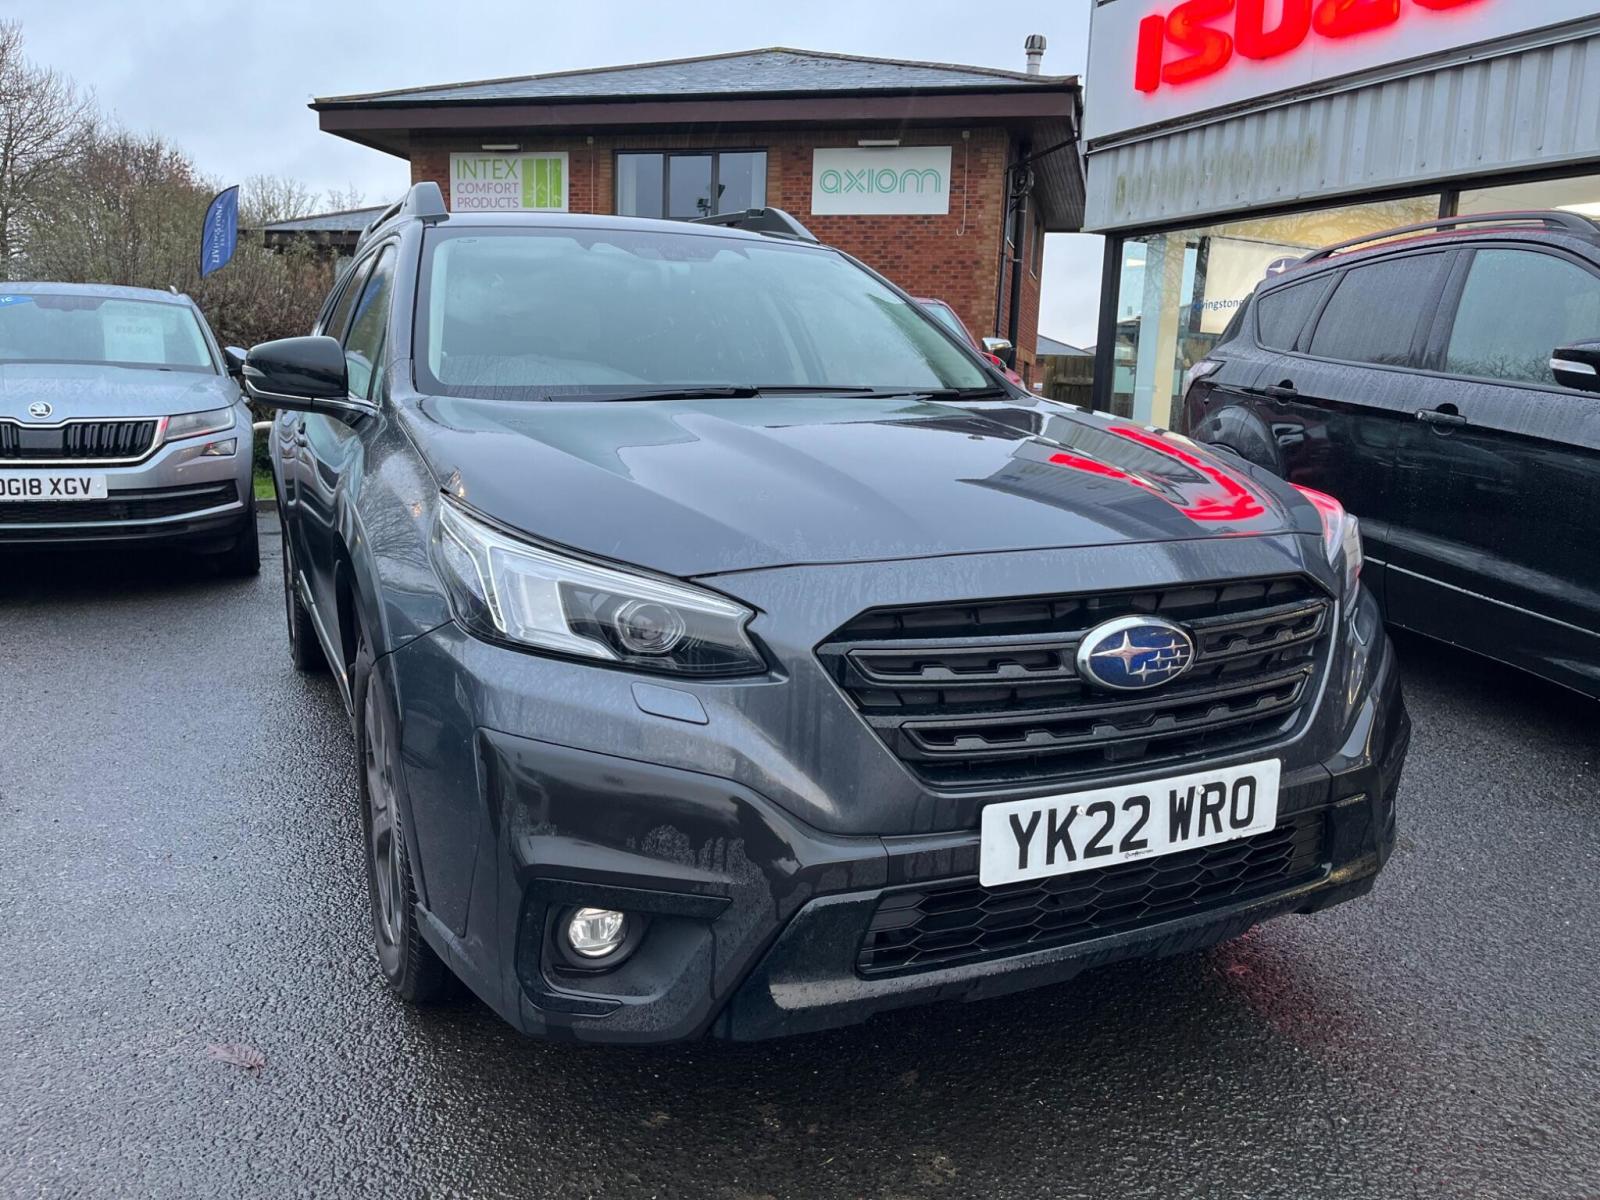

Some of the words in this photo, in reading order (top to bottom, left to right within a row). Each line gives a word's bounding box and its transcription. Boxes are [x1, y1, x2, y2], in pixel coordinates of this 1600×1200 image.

[1134, 0, 1485, 93] ISU
[456, 158, 519, 180] INTEX
[456, 182, 519, 194] COMFORT
[819, 168, 941, 194] axiom
[456, 197, 519, 209] PRODUCTS
[48, 477, 92, 496] XGV
[1008, 794, 1151, 870] YK22
[1168, 775, 1257, 844] WRO
